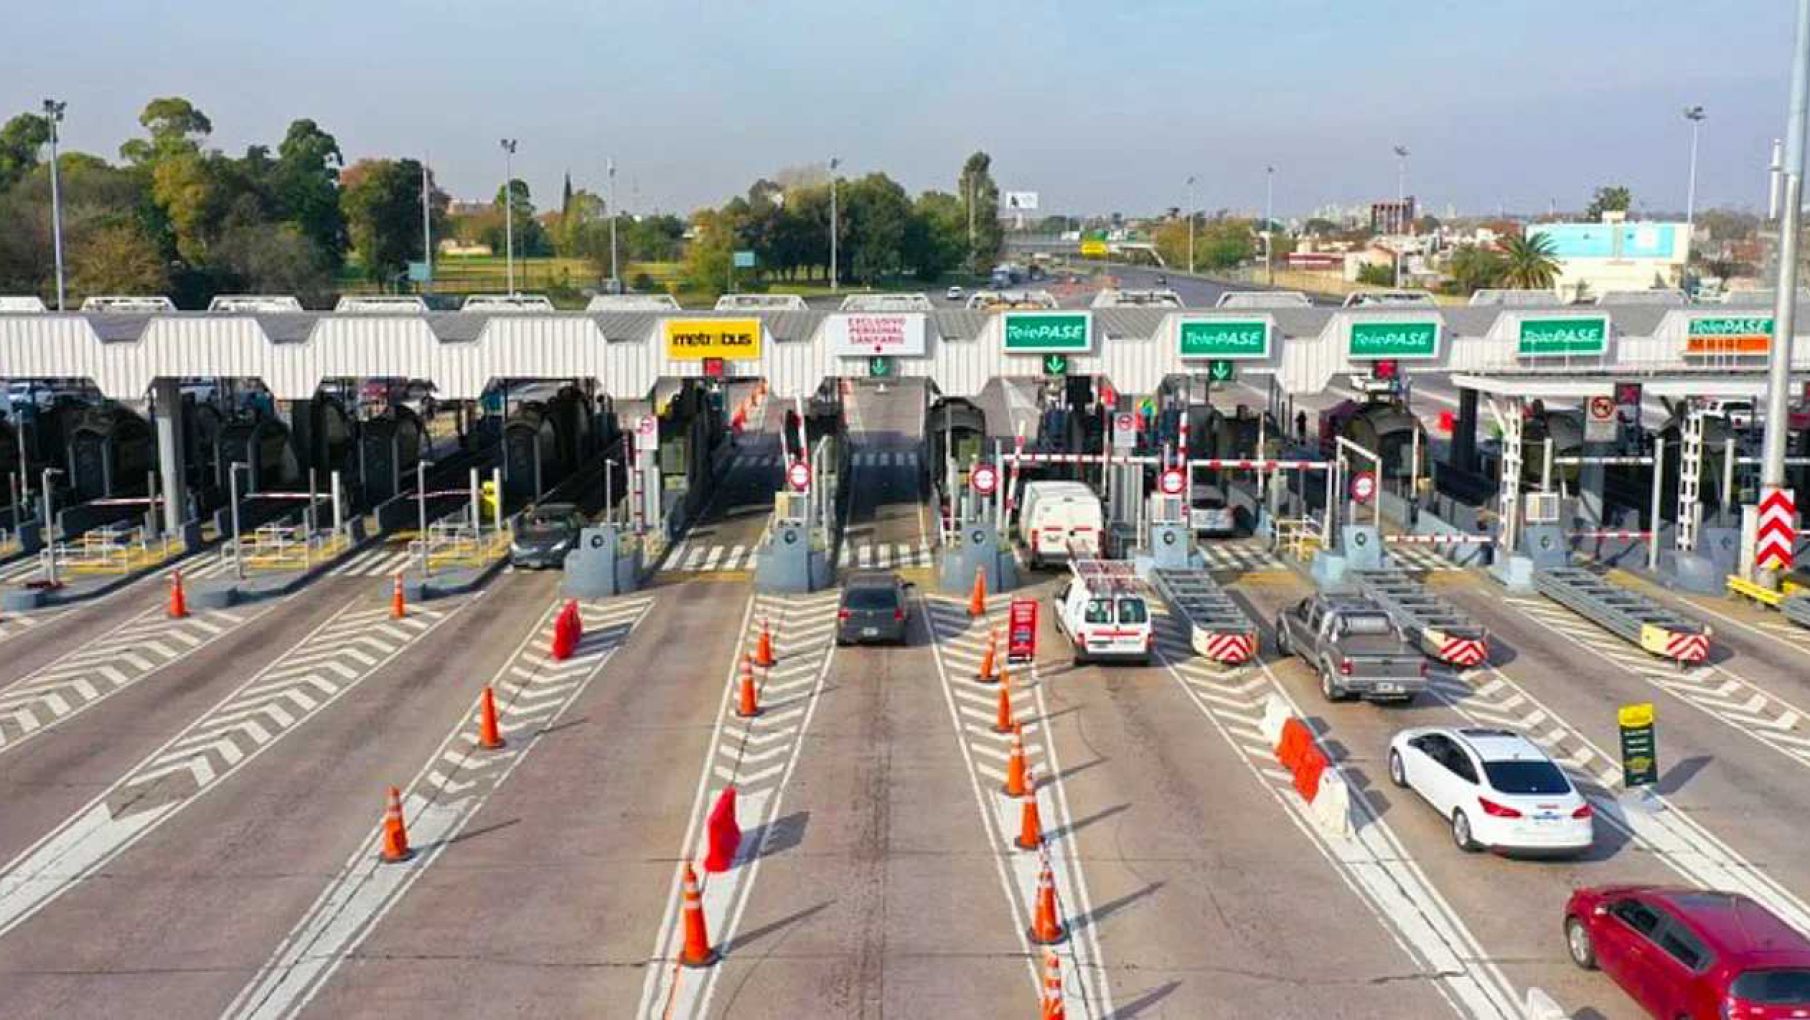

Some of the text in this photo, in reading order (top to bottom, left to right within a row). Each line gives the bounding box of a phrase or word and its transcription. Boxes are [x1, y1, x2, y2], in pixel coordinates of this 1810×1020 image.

[848, 317, 906, 326] EXCLUSIVO
[849, 326, 905, 334] PERSONAL
[1008, 324, 1083, 340] TelePASE
[1524, 328, 1599, 343] TelePASE
[849, 335, 905, 344] SANITARIO
[1186, 332, 1262, 346] TelePASE
[1354, 332, 1430, 346] TelePASE
